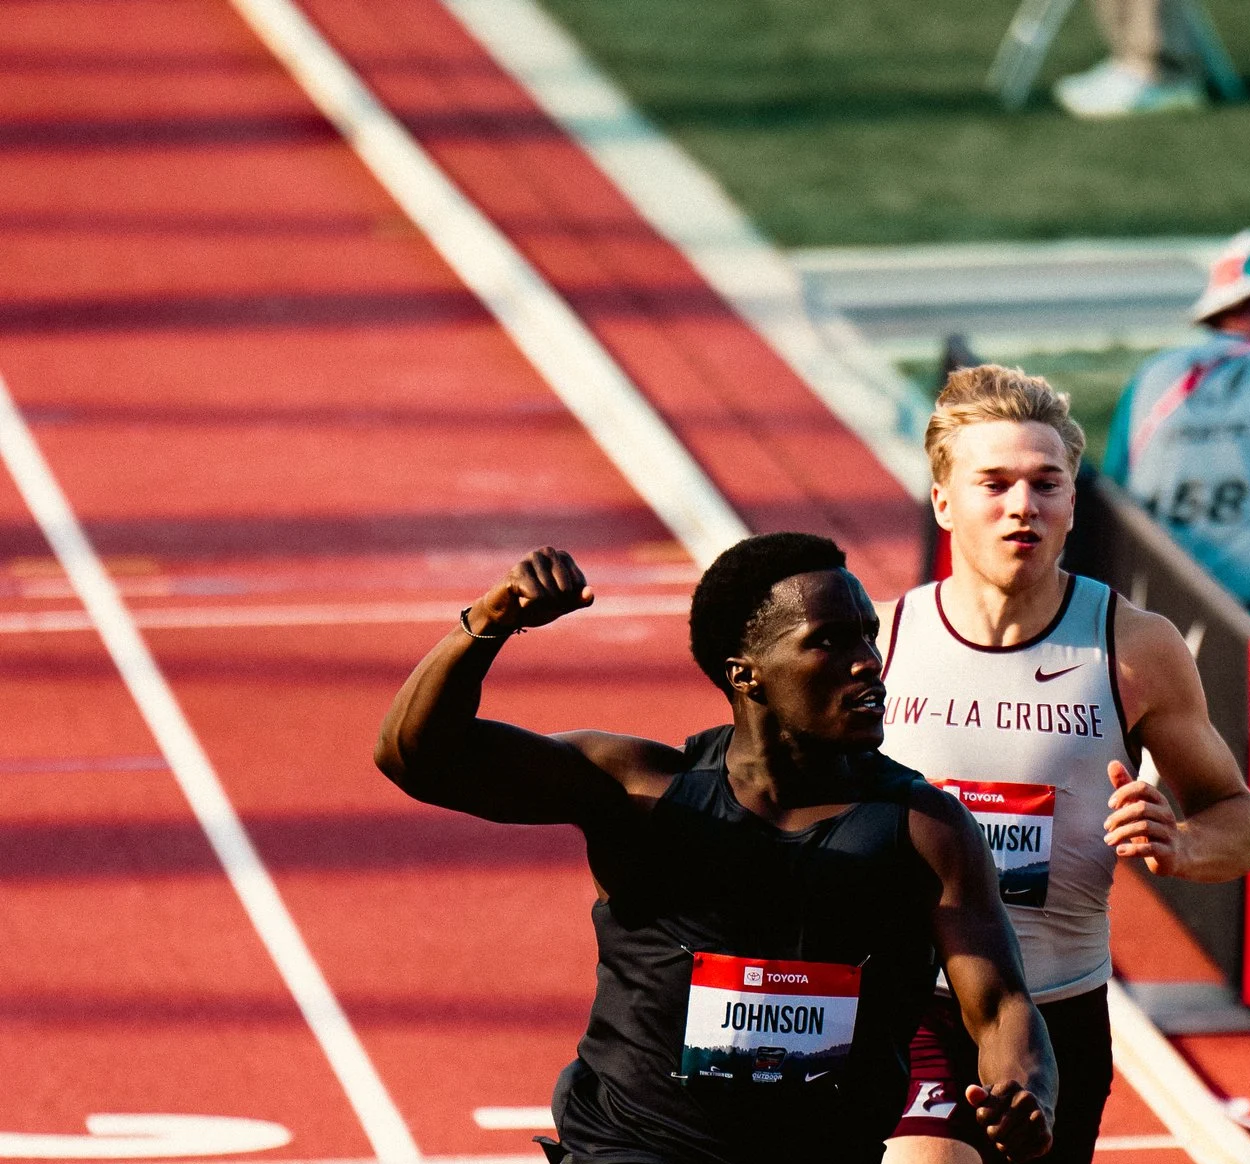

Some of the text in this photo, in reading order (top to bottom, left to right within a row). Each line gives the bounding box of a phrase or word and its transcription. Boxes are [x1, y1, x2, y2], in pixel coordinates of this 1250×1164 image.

[996, 702, 1104, 739] CROSSE
[962, 791, 1005, 803] TOYOTA
[766, 973, 809, 984] TOYOTA
[721, 1001, 825, 1035] JOHNSON
